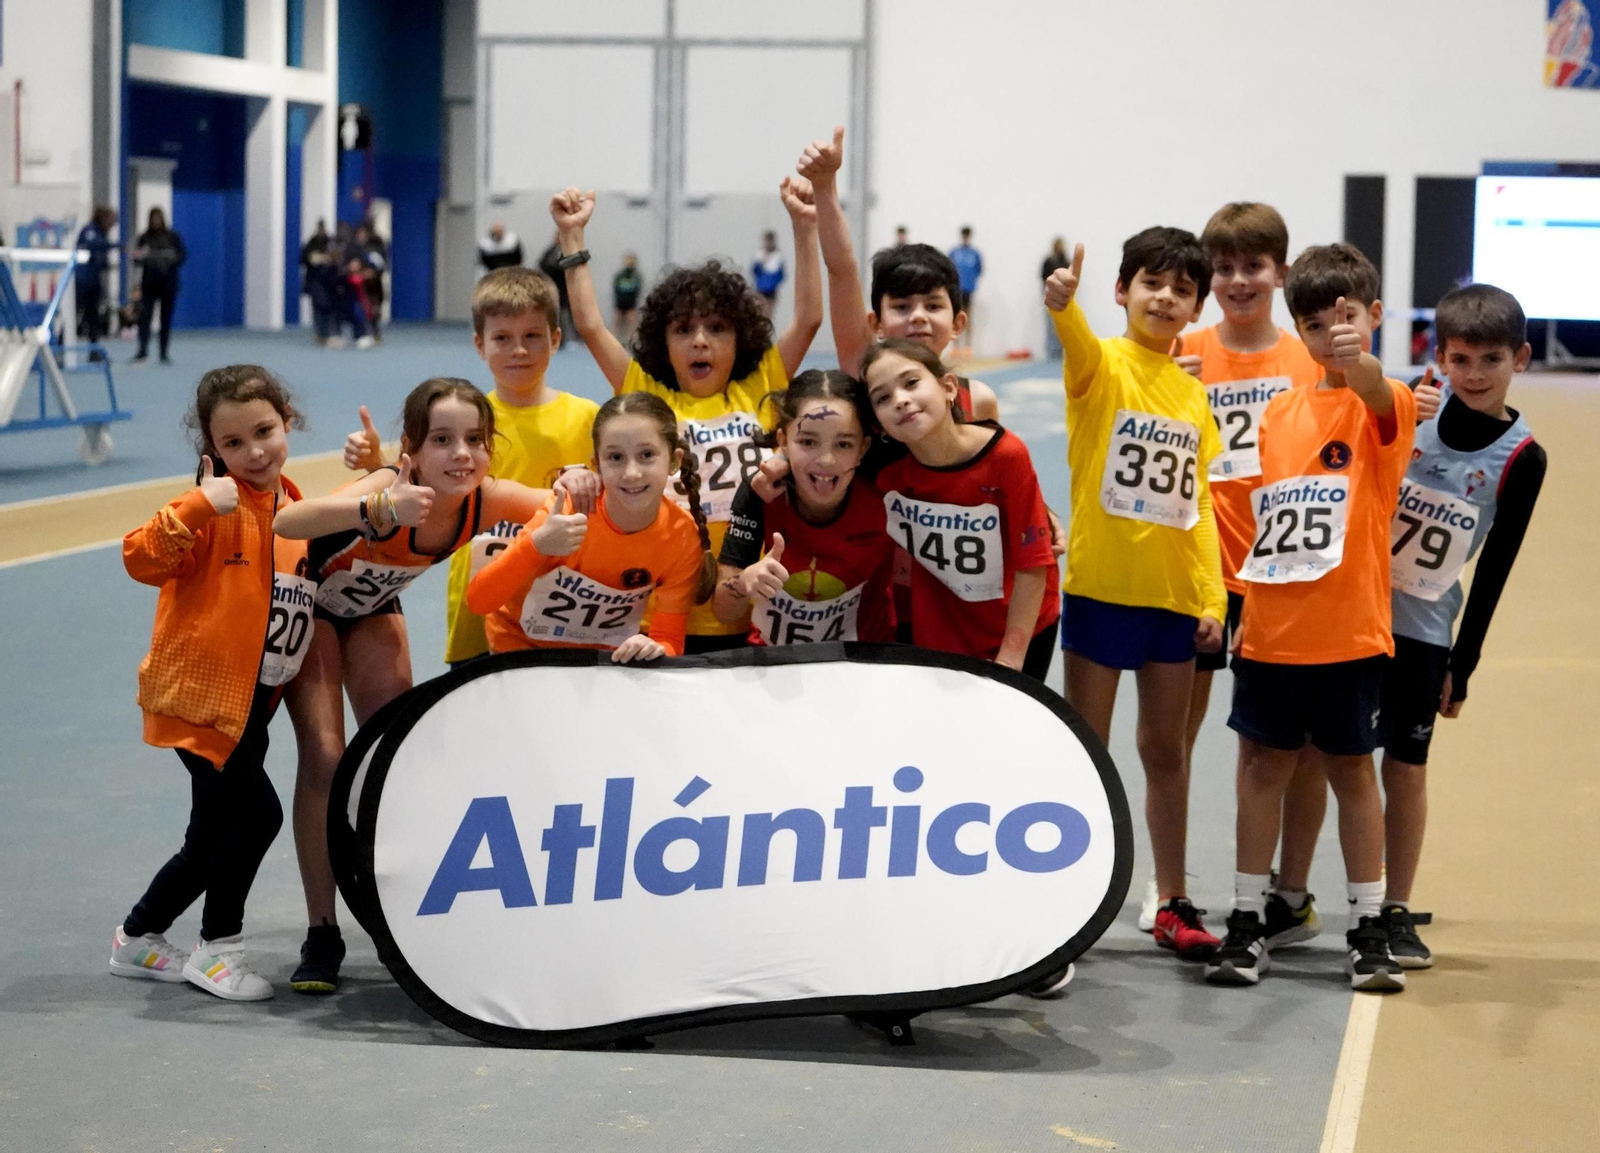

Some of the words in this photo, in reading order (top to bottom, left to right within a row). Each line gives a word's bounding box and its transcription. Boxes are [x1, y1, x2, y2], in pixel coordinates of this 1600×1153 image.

[1213, 410, 1255, 451] 2
[1114, 443, 1196, 501] 336
[889, 498, 998, 533] Atlántico
[1259, 481, 1347, 515] Atlántico
[1398, 486, 1476, 531] lántico
[899, 521, 987, 575] 148
[1253, 507, 1332, 558] 225
[541, 590, 634, 630] 212
[416, 765, 1092, 917] Atlántico
